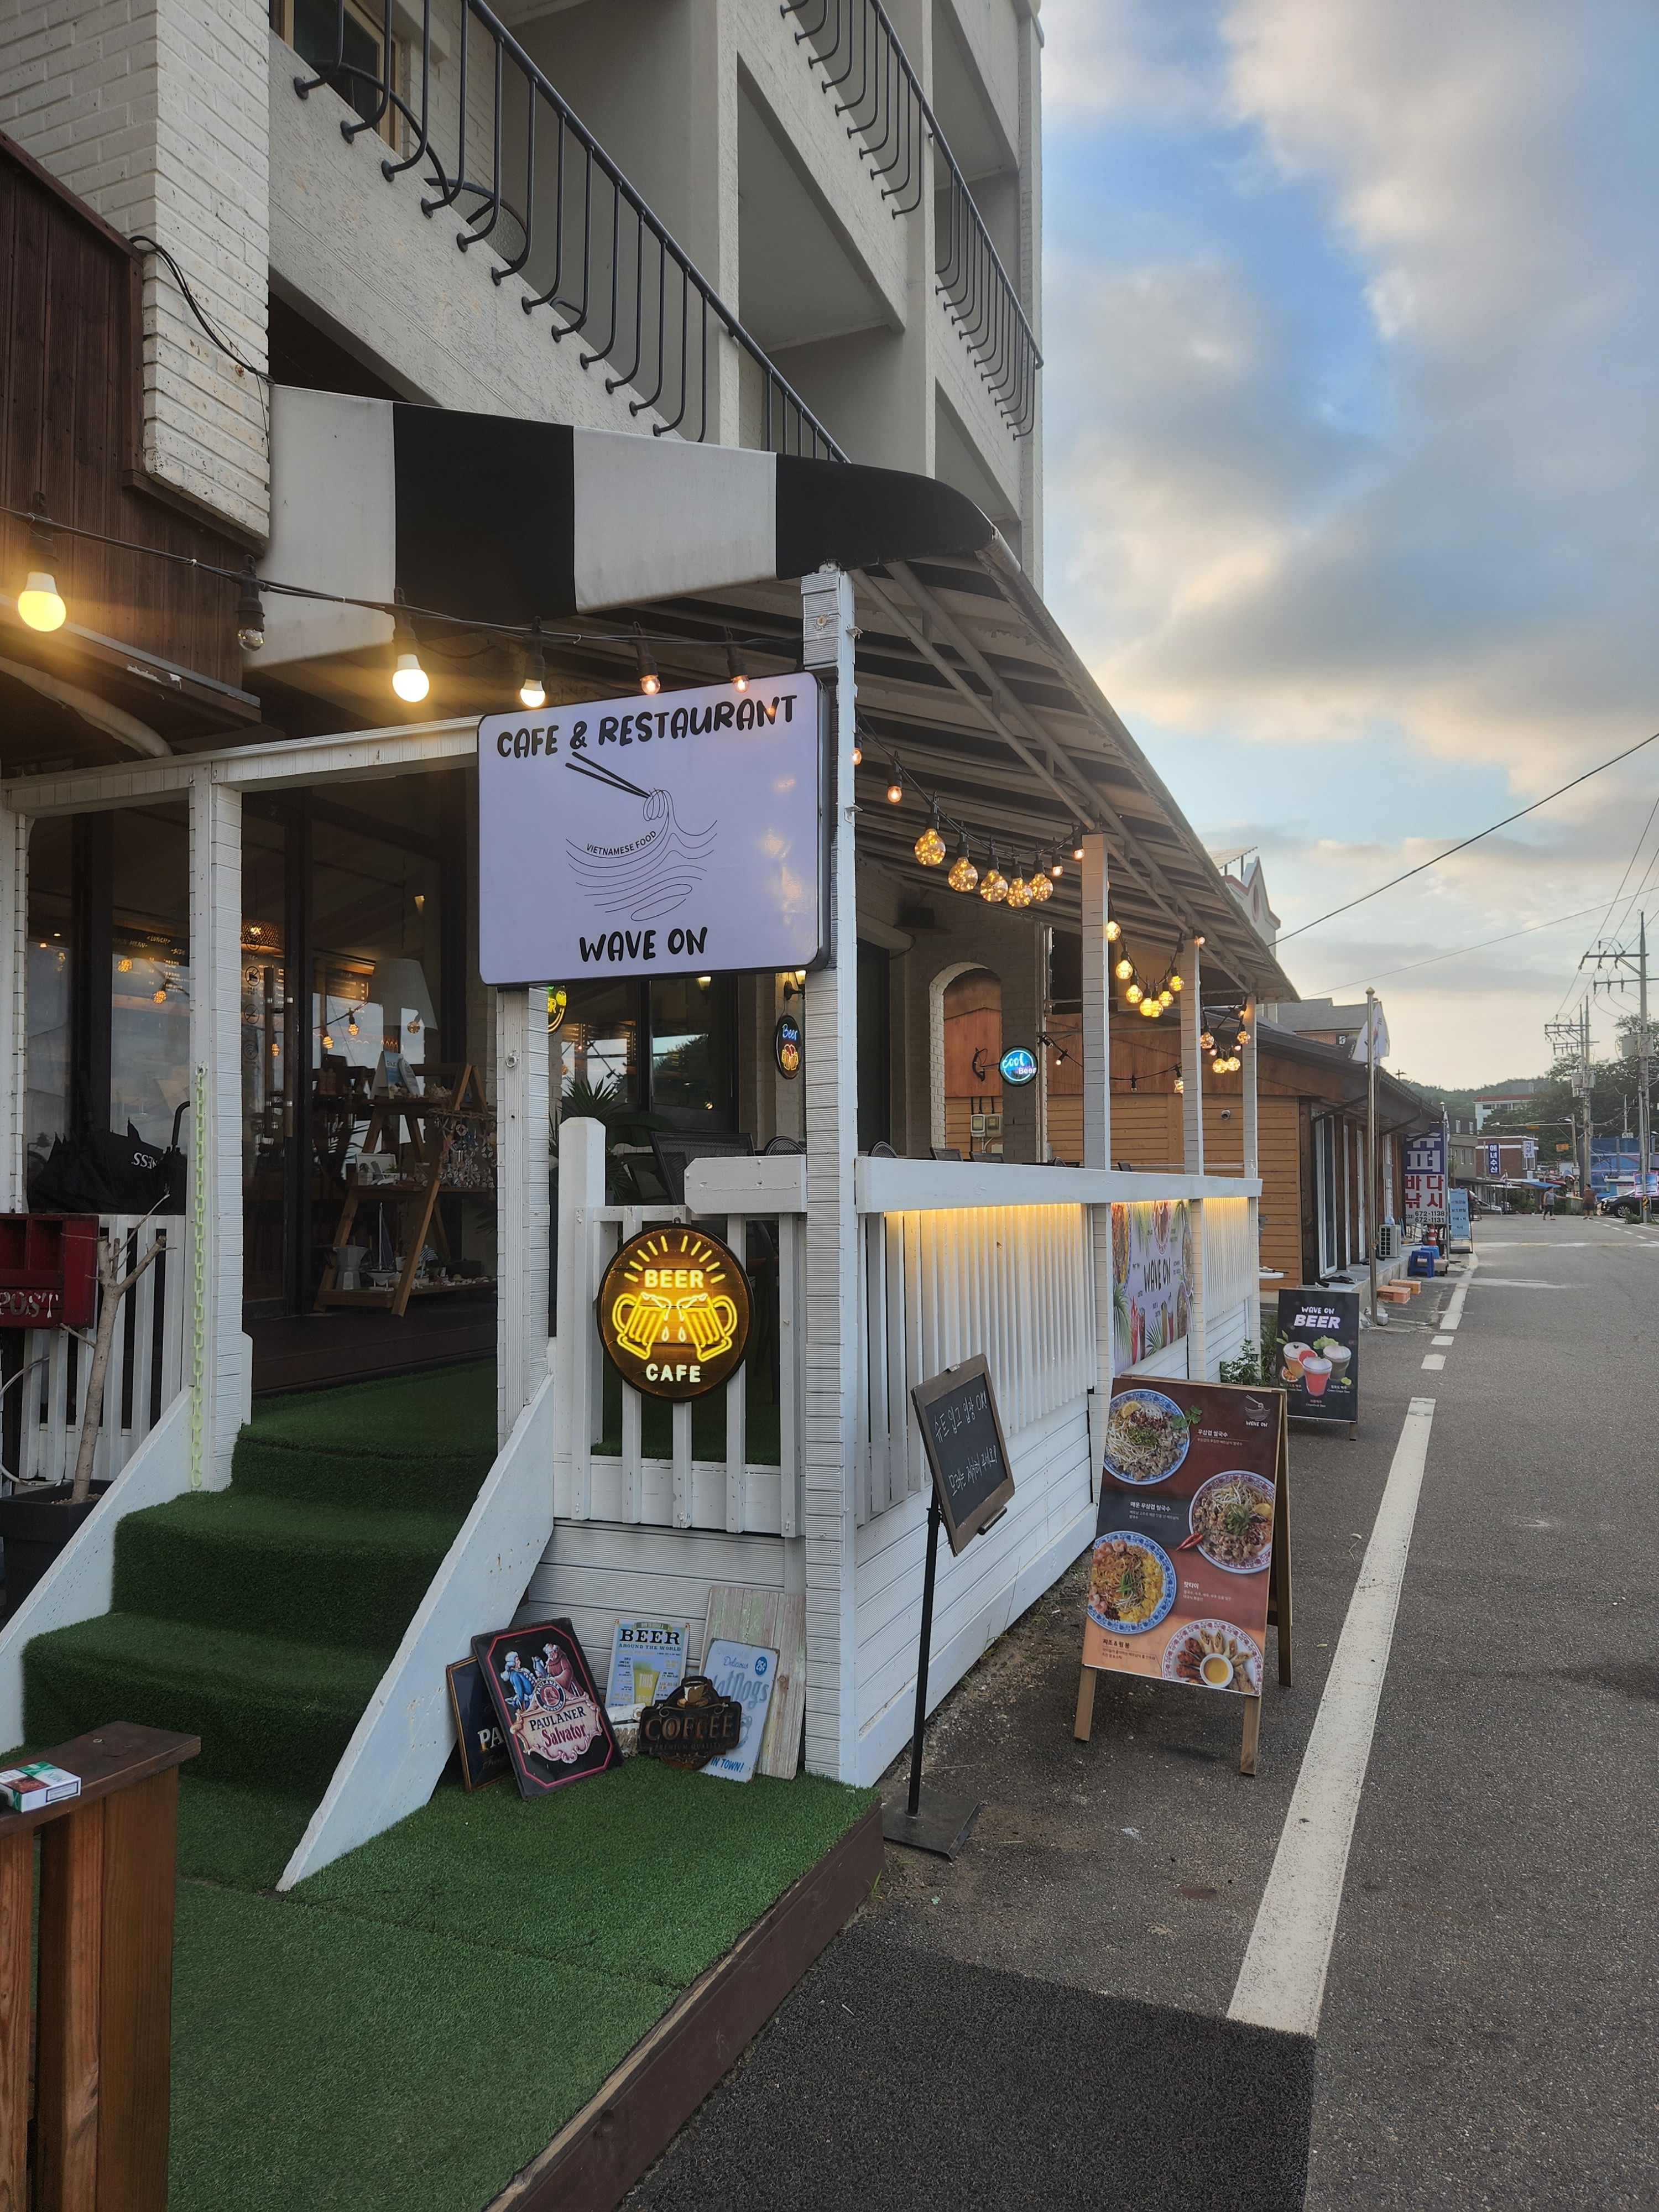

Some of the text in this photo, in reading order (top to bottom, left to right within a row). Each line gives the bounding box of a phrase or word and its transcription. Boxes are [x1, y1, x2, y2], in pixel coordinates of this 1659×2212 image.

[497, 695, 797, 758] CAFE & RESTAURANT
[586, 831, 656, 855] VIETNAMESE FOOD
[579, 926, 708, 962] WAVE ON
[782, 1024, 797, 1040] Beer
[1405, 1175, 1444, 1191] 바다
[1405, 1193, 1443, 1209] 낚시
[644, 1270, 704, 1288] BEER
[1144, 1258, 1171, 1293] WAVE ON
[1294, 1314, 1340, 1329] BEER
[646, 1364, 701, 1383] CAFE
[934, 1390, 987, 1443] 슈트 입고 입장 OK!
[1184, 1581, 1199, 1589] 팟타이
[619, 1629, 680, 1645] BEER
[723, 1656, 749, 1669] Delicious
[536, 1680, 560, 1694] PAULANER
[639, 1673, 653, 1688] THIS
[529, 1706, 587, 1731] PAULANER
[541, 1724, 586, 1747] Salvator
[645, 1715, 733, 1741] COFFEE
[477, 1726, 504, 1752] PA
[711, 1756, 744, 1772] IN TOWN!
